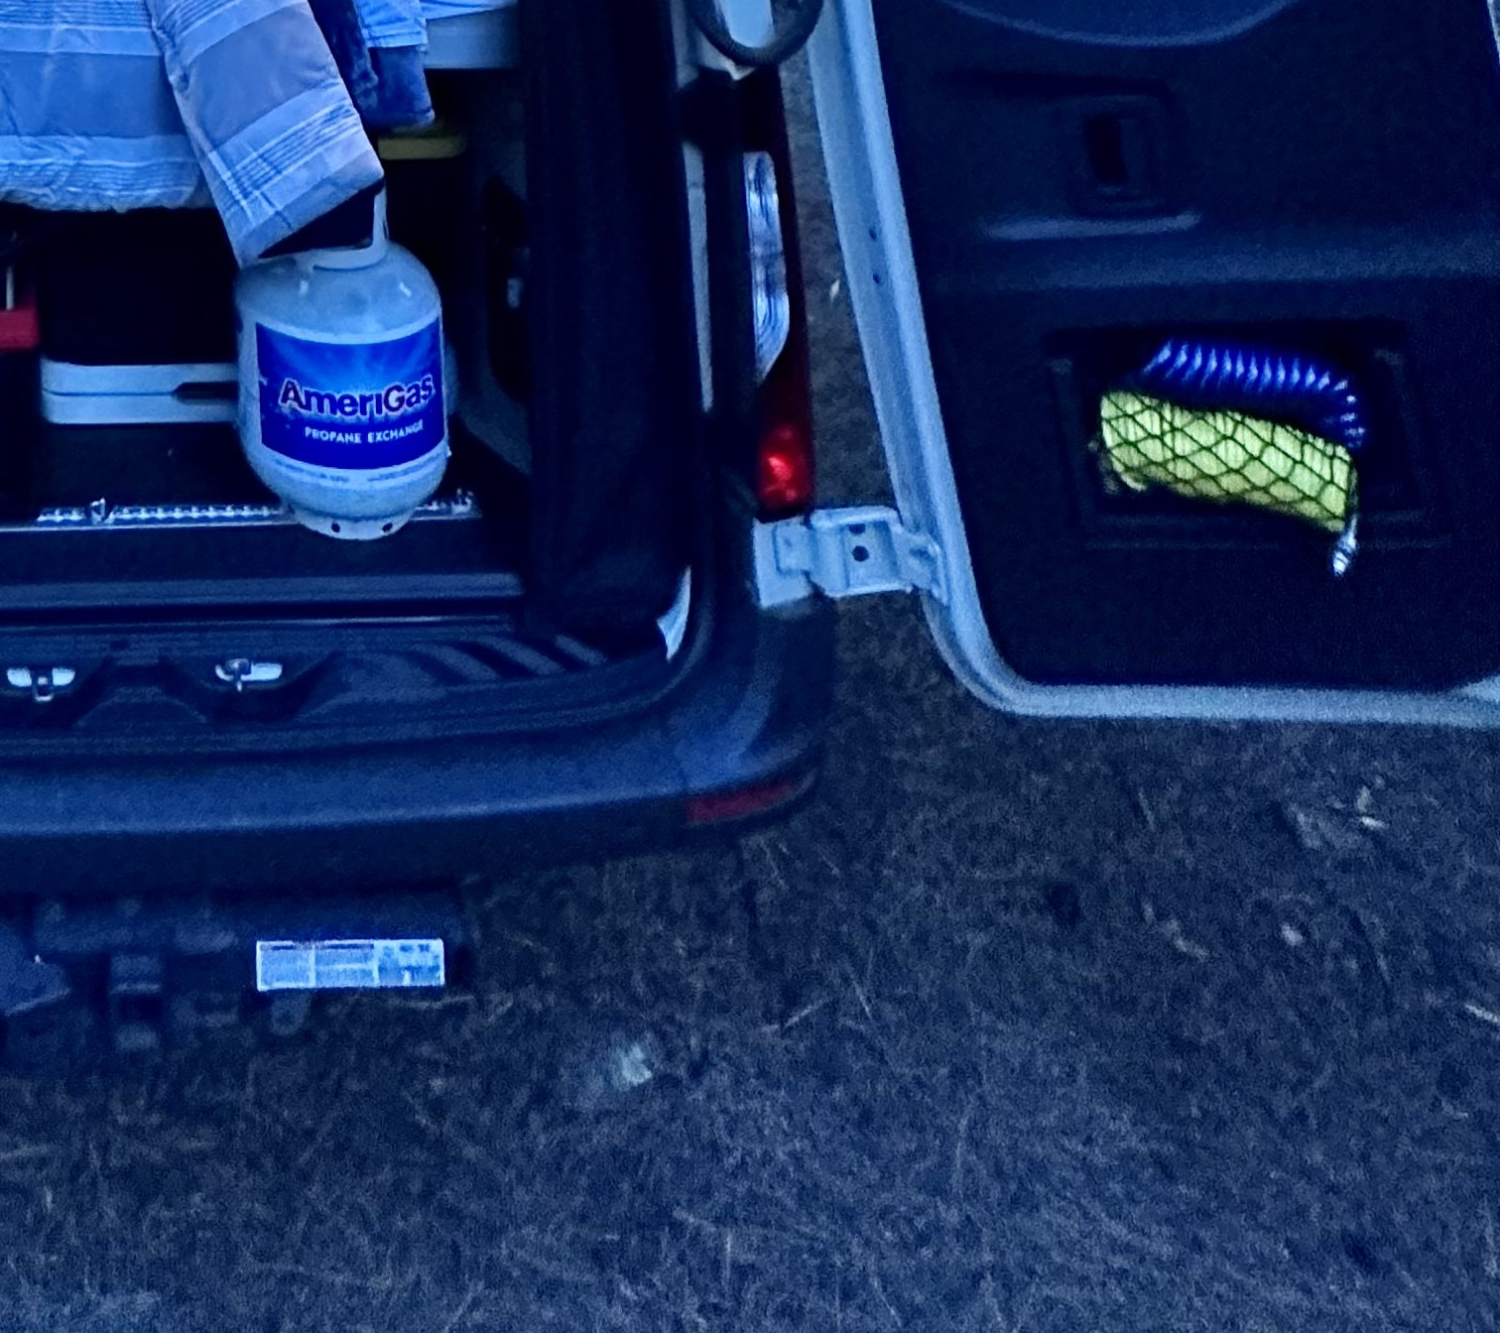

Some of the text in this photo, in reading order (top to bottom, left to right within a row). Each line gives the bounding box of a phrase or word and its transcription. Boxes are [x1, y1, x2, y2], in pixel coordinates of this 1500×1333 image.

[279, 373, 436, 417] AmeriGas
[304, 419, 424, 445] PROPANE EXCHANGE
